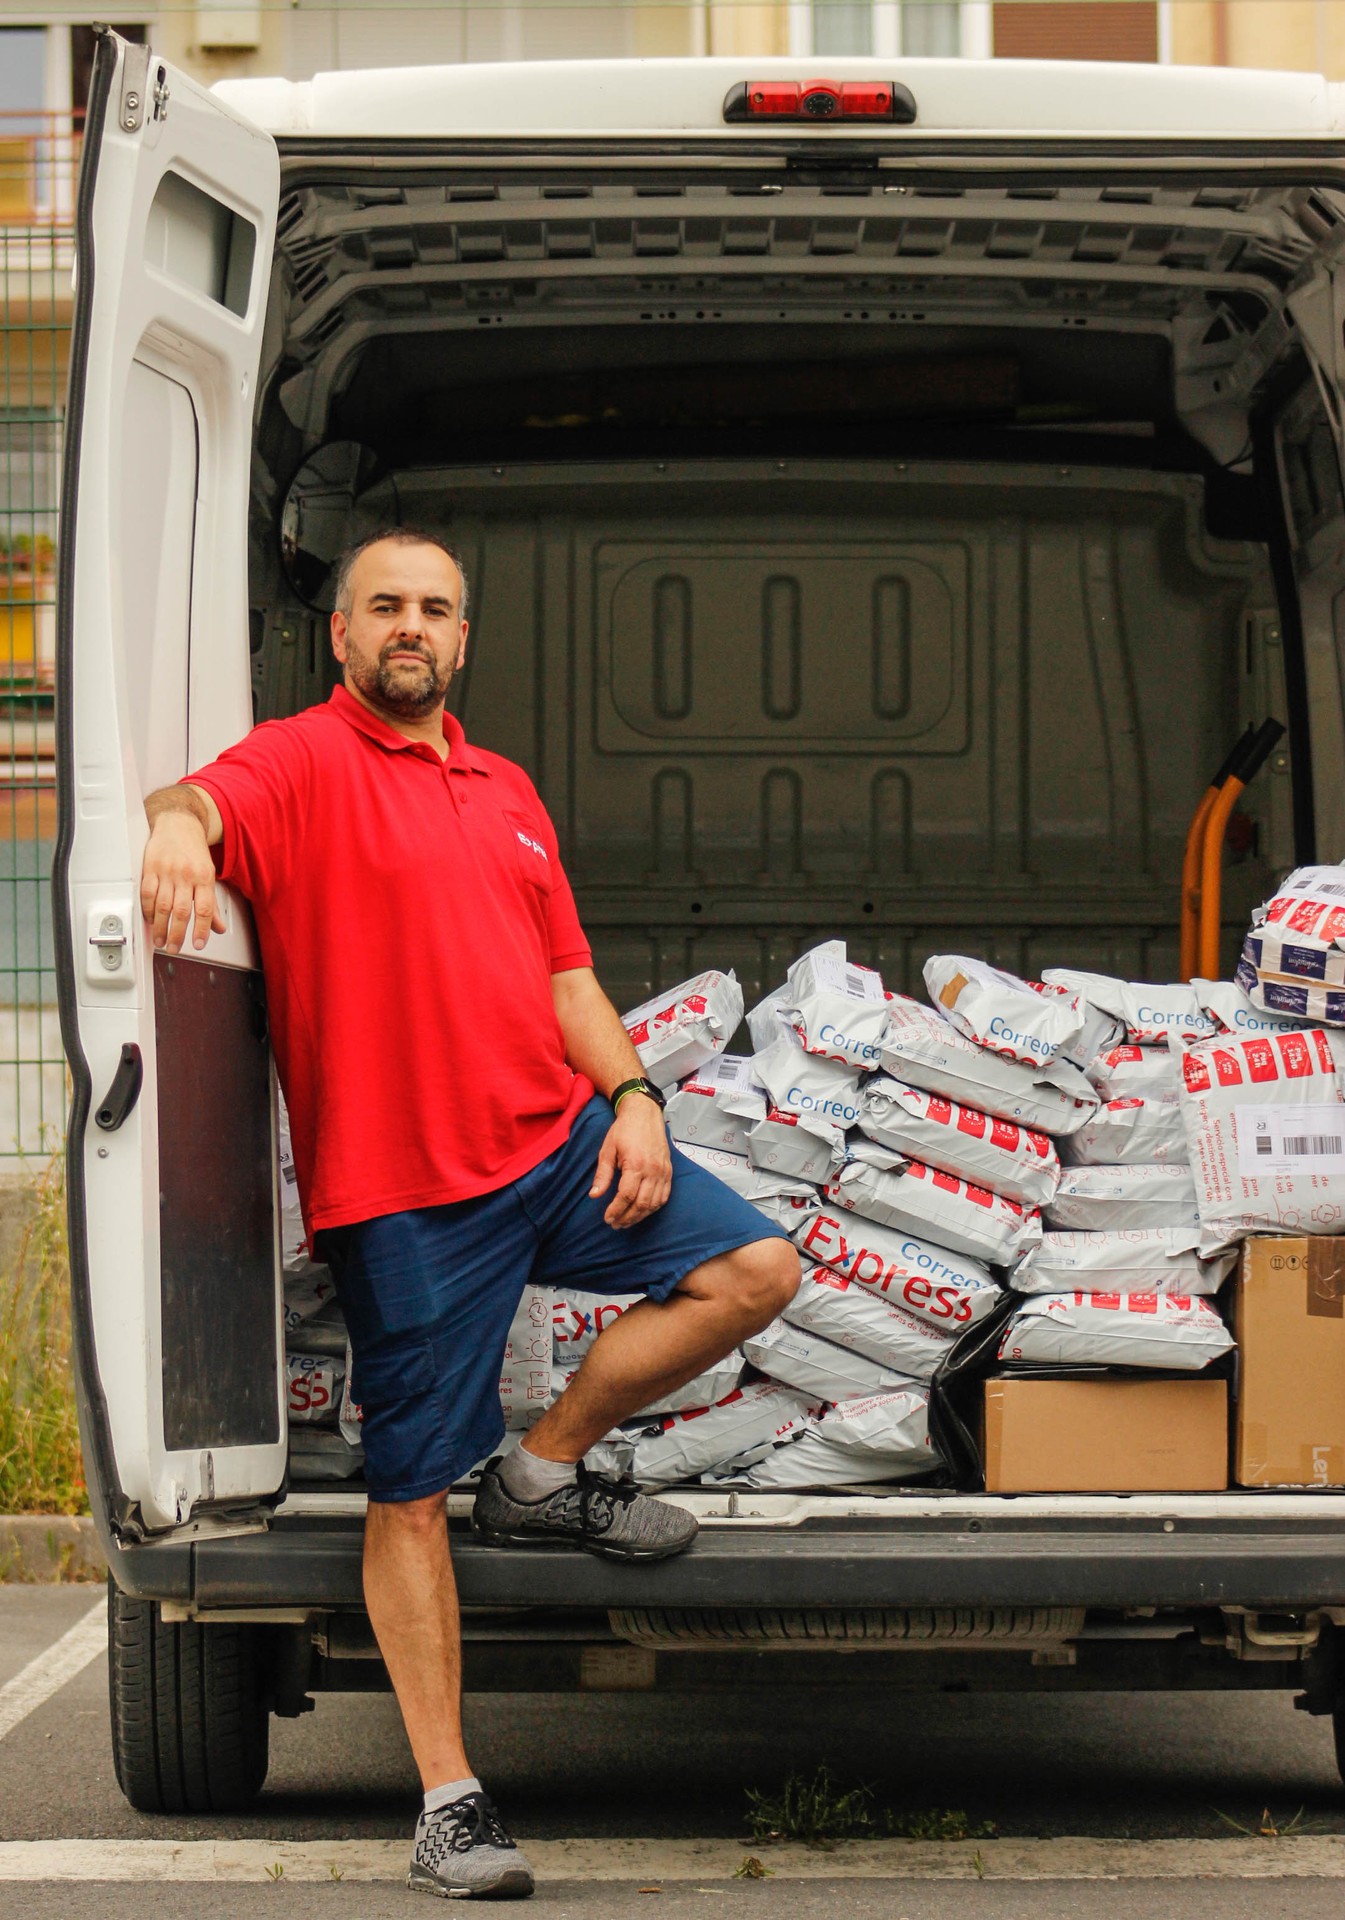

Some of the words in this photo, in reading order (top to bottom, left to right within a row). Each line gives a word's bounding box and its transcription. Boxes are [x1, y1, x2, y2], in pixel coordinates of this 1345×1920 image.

[819, 1024, 881, 1060] Correo
[990, 1016, 1060, 1056] Correos
[1252, 1053, 1261, 1068] 24h
[1259, 1052, 1268, 1066] Paq
[1287, 1048, 1299, 1070] 14:00
[1295, 1047, 1303, 1062] Paq
[1213, 1119, 1224, 1153] Servicio
[1197, 1138, 1205, 1160] antes
[1199, 1099, 1208, 1127] origen
[1205, 1133, 1215, 1163] destino
[1211, 1165, 1222, 1203] empresas
[1201, 1161, 1207, 1173] de
[1218, 1153, 1230, 1186] especial
[1203, 1174, 1211, 1185] las
[1251, 1178, 1259, 1197] para
[1276, 1181, 1285, 1194] sol
[1286, 1182, 1294, 1193] de
[1321, 1176, 1329, 1187] de
[1225, 1186, 1233, 1201] con
[802, 1214, 973, 1322] Express
[901, 1242, 988, 1290] Correo
[553, 1302, 634, 1342] Exp
[907, 1321, 918, 1331] de
[1012, 1348, 1022, 1359] 20
